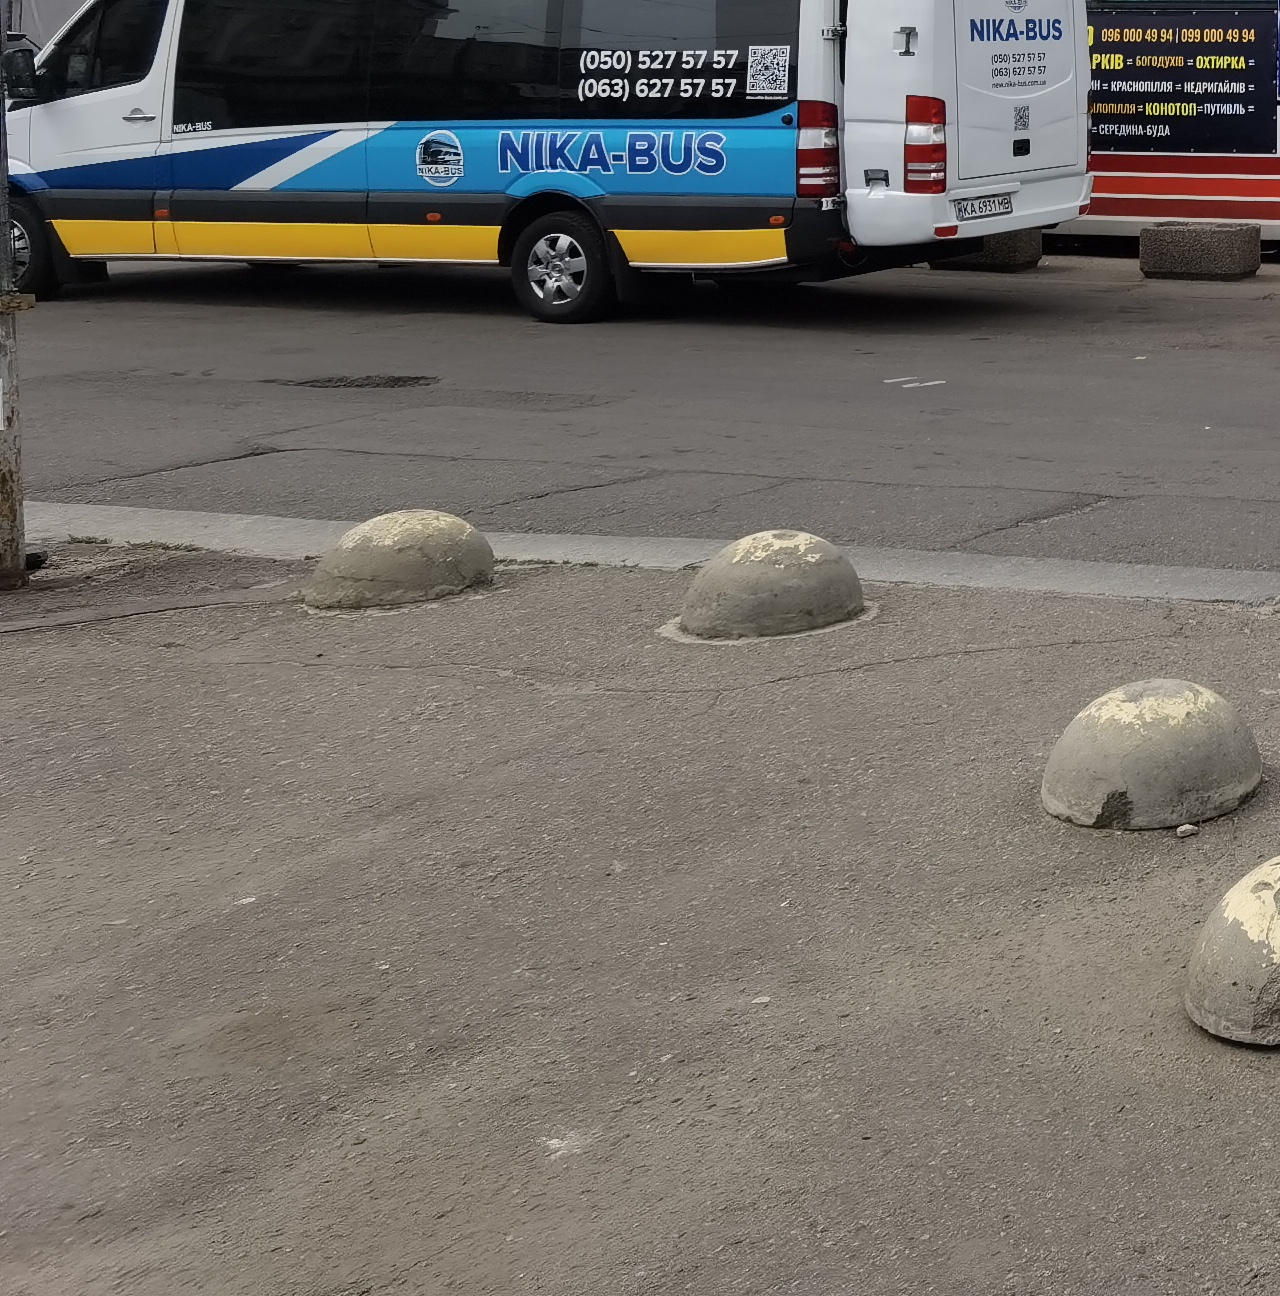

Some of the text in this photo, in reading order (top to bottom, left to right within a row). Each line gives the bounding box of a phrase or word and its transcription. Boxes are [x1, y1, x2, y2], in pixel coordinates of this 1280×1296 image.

[970, 19, 1063, 42] NIKA-BUS
[1101, 28, 1120, 42] 096
[1123, 28, 1143, 42] 000
[1144, 28, 1158, 42] 49
[1160, 28, 1173, 43] 94
[1181, 28, 1201, 43] 099
[1203, 28, 1223, 43] 000
[1226, 28, 1239, 43] 49
[1242, 28, 1255, 43] 94
[579, 49, 738, 74] (050) 527 57 57
[991, 54, 1010, 65] (050)
[1135, 56, 1184, 68] БОГОДУХІВ
[1196, 56, 1246, 69] ОХТИРКА
[991, 67, 1010, 78] (063)
[577, 78, 737, 101] (063) 627 57 57
[1111, 80, 1173, 92] КРАСНОПІЛЛЯ
[1184, 79, 1246, 94] НЕДРИГАЙЛІВ
[1145, 103, 1197, 116] КОНОТОП
[1204, 103, 1246, 117] ПУТИВЛЬ
[173, 121, 212, 134] NIKA-BUS
[1099, 124, 1171, 137] СЕРЕДИНА-БУДА
[498, 130, 727, 175] NIKA-BUS
[418, 165, 463, 176] NIKA-BUS
